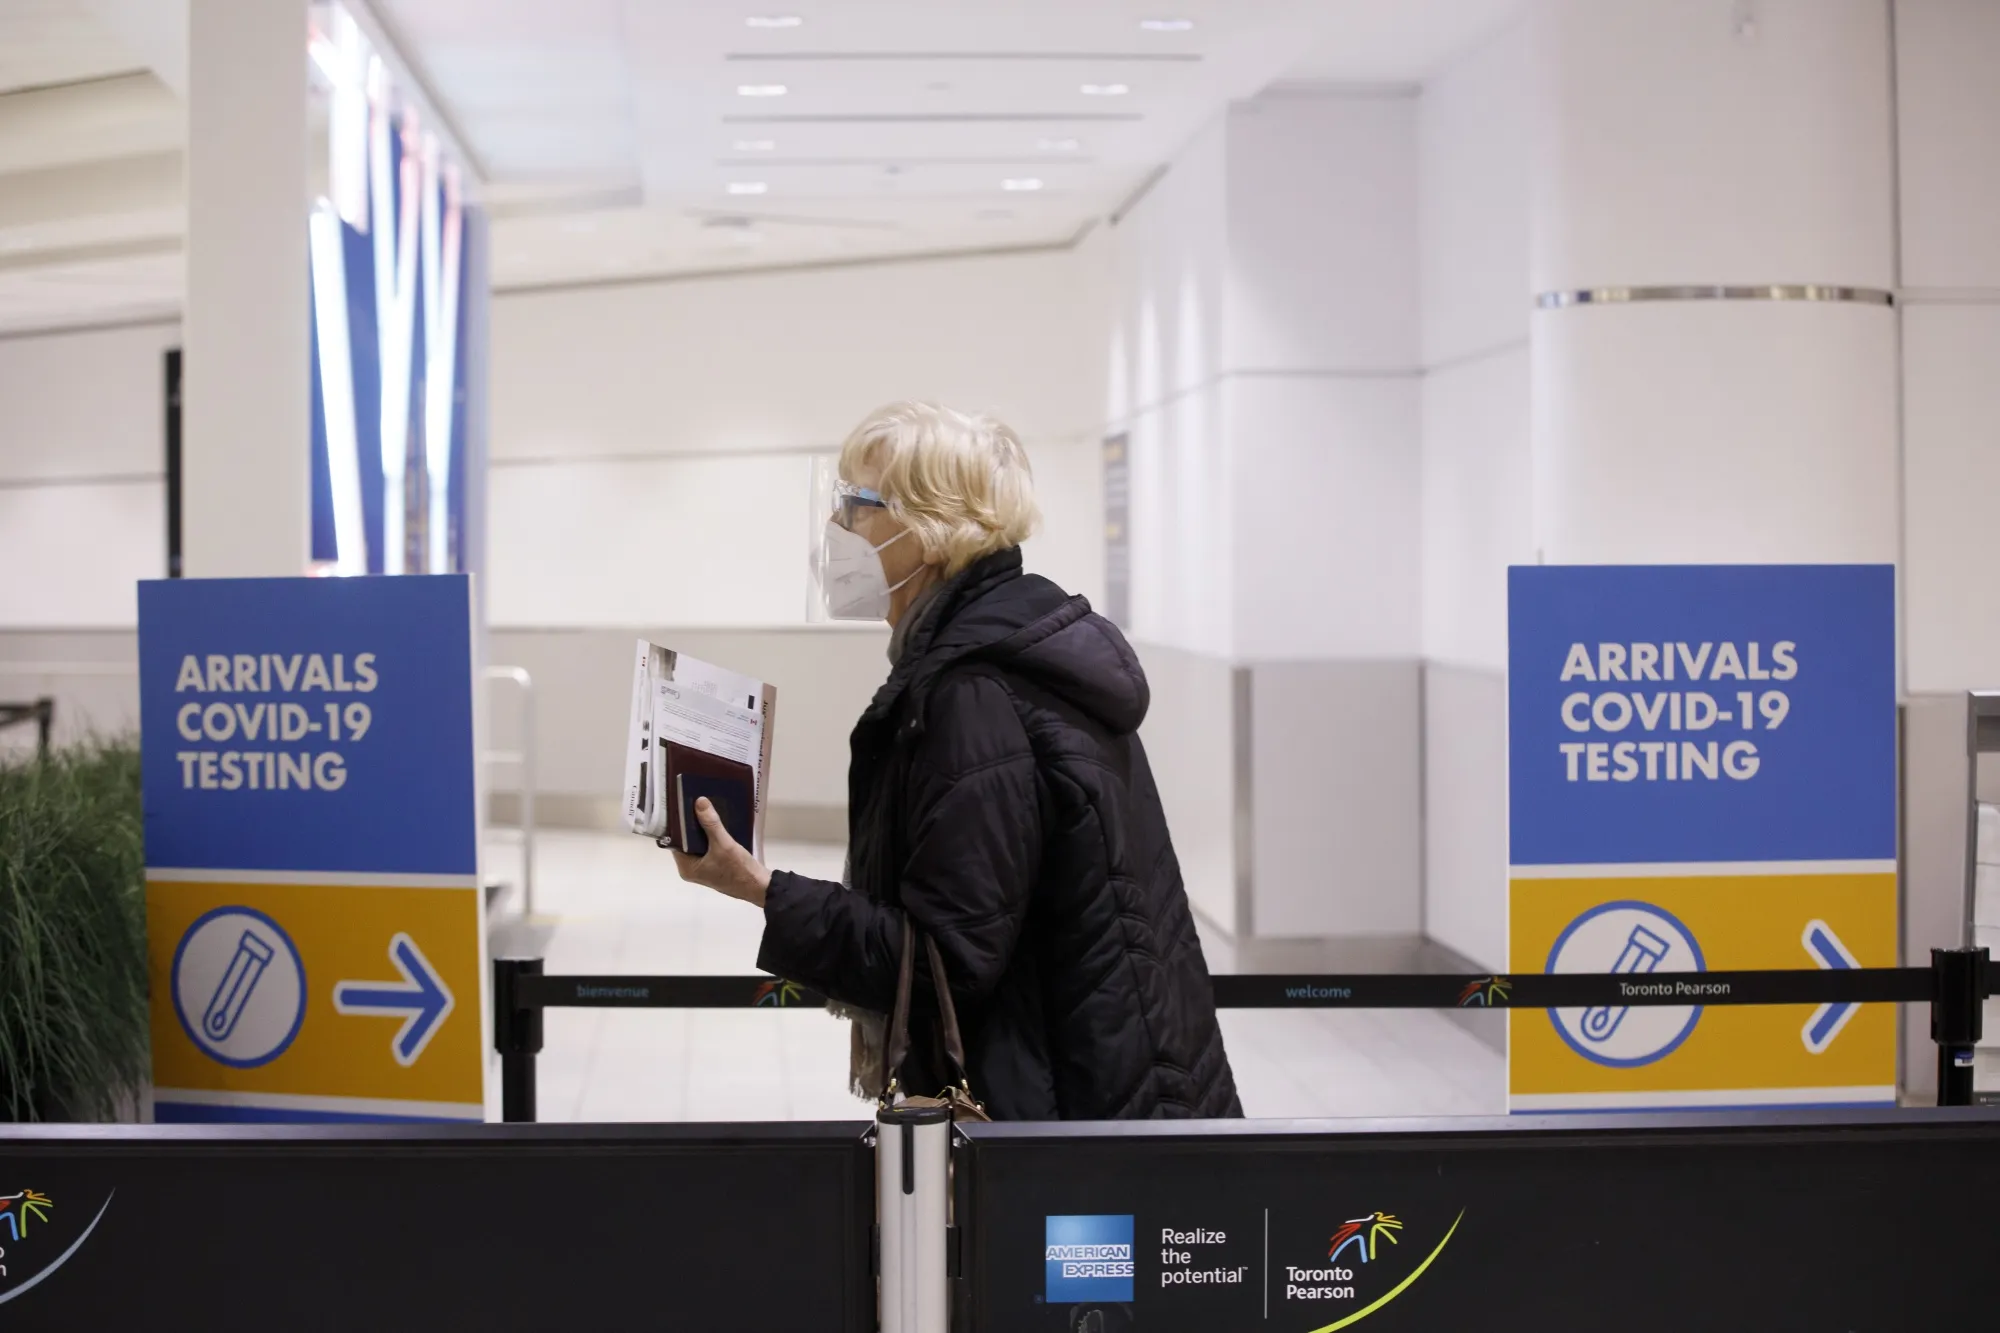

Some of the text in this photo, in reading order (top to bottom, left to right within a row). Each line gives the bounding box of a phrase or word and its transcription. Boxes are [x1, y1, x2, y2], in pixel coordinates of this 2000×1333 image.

[1559, 640, 1798, 681] ARRIVALS
[175, 653, 379, 692] ARRIVALS
[1560, 690, 1790, 732] COVID-19
[177, 702, 372, 742] COVID-19
[1559, 740, 1760, 781] TESTING
[176, 751, 348, 791] TESTING
[576, 984, 649, 999] bienvenue
[1285, 984, 1352, 999] welcome
[1619, 980, 1731, 996] Toronto Pearson
[1161, 1228, 1227, 1245] Realize
[1046, 1245, 1130, 1261] AMERICAN
[1161, 1248, 1191, 1264] the
[1063, 1263, 1134, 1278] EXPRESS
[1285, 1266, 1354, 1282] Toronto
[1286, 1284, 1355, 1300] Pearson
